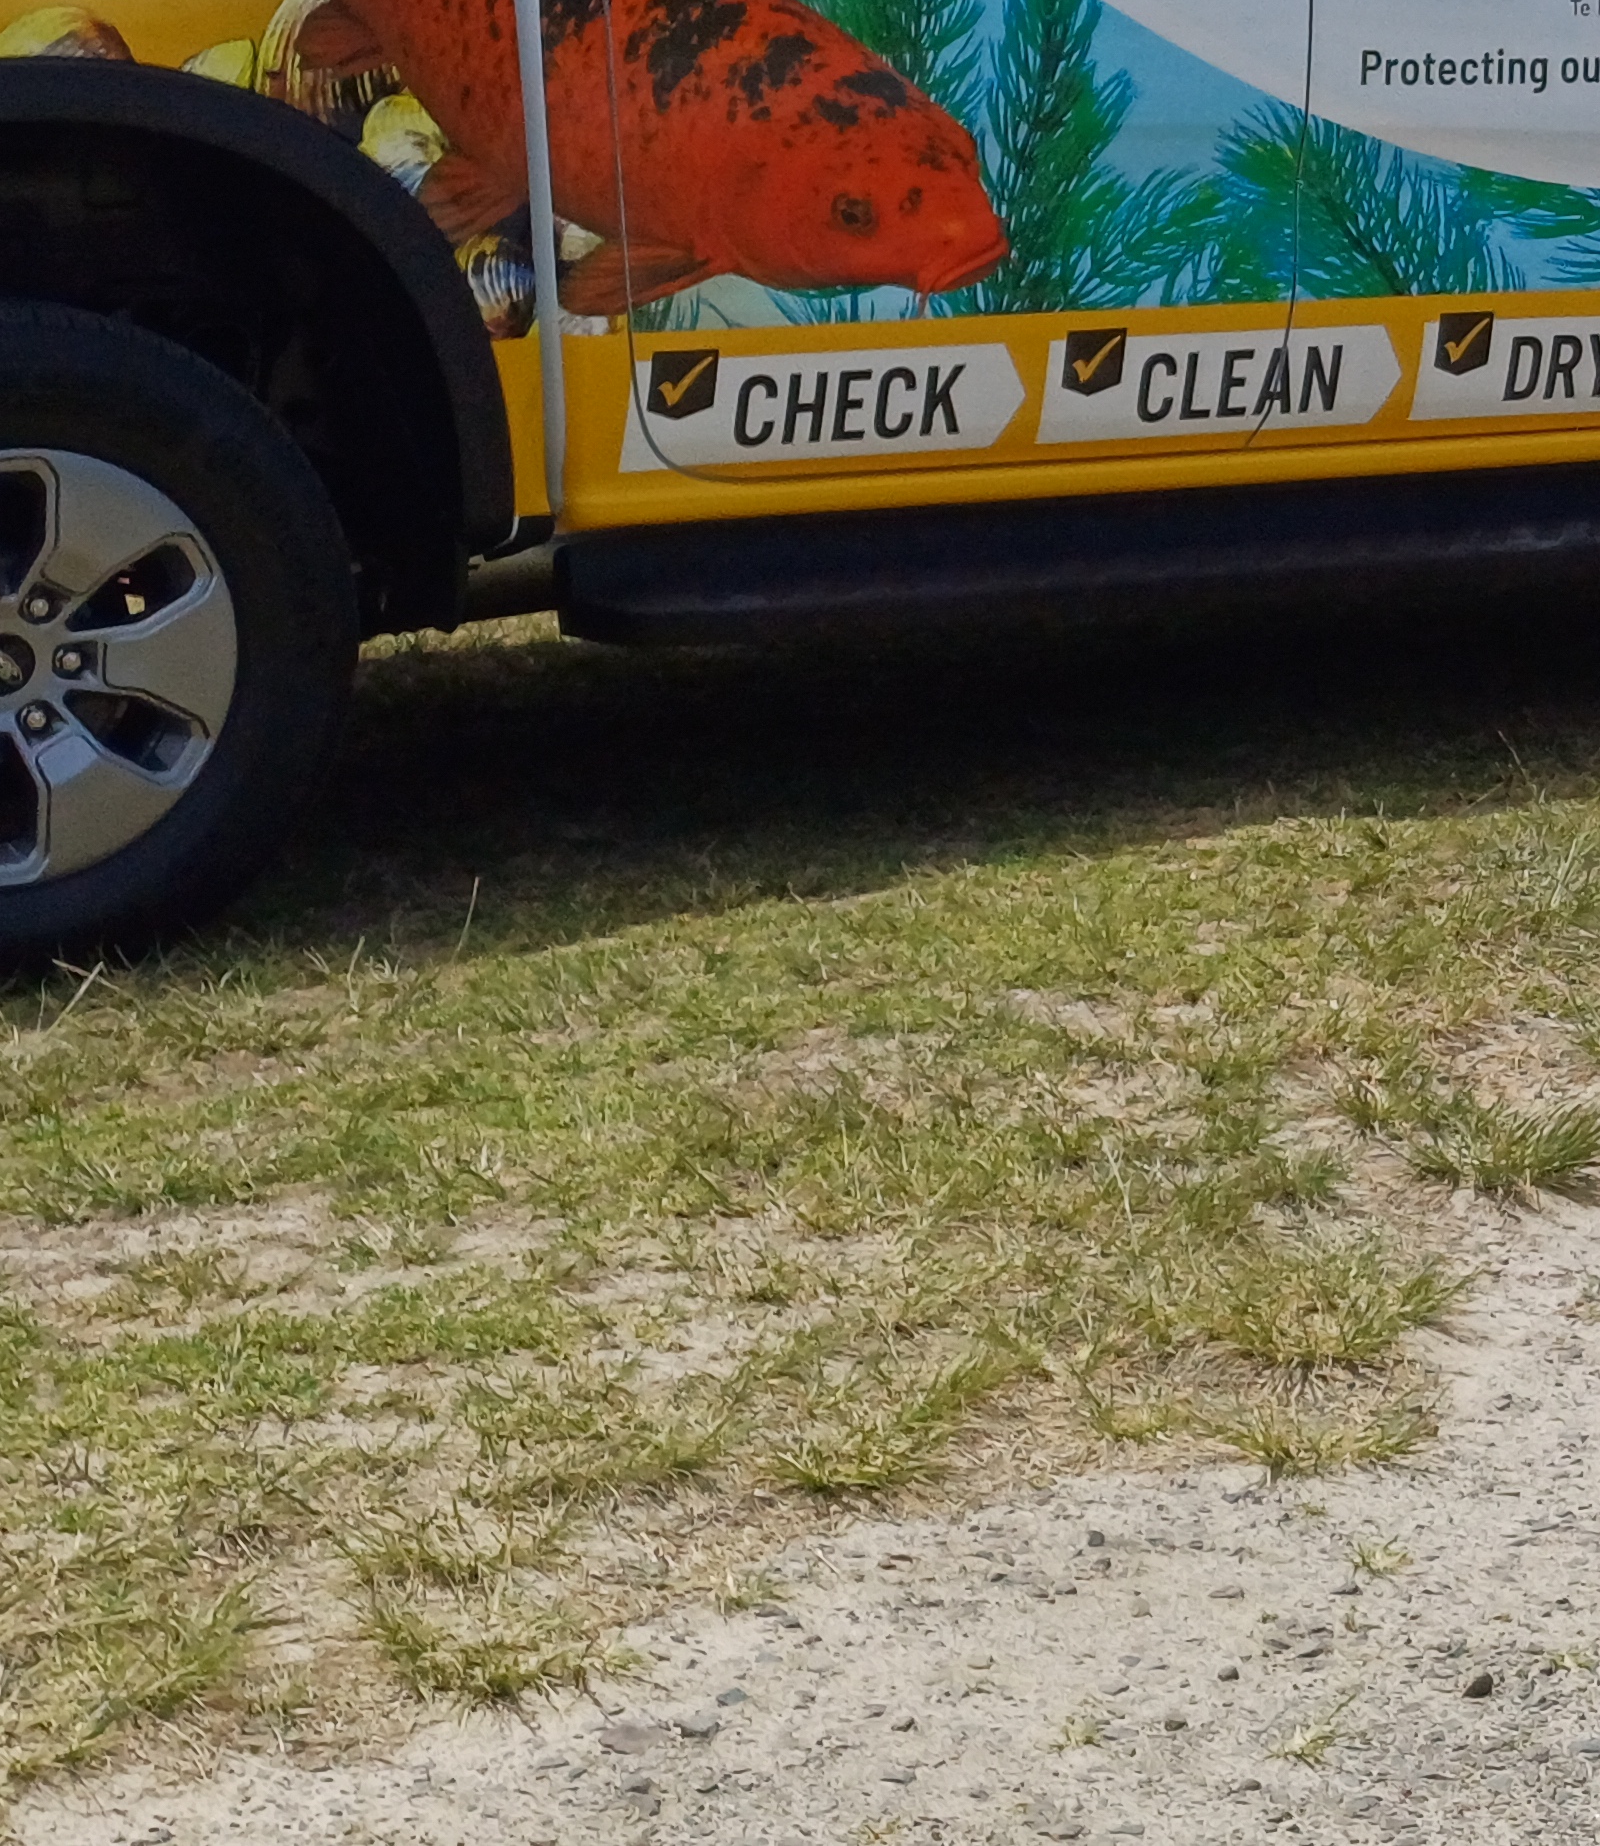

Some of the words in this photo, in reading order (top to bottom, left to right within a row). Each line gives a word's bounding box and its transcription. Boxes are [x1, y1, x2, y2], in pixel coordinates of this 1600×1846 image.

[1571, 0, 1590, 16] Te
[1359, 45, 1549, 94] Protecting
[732, 358, 963, 448] CHECK
[1135, 343, 1344, 426] CLEAN
